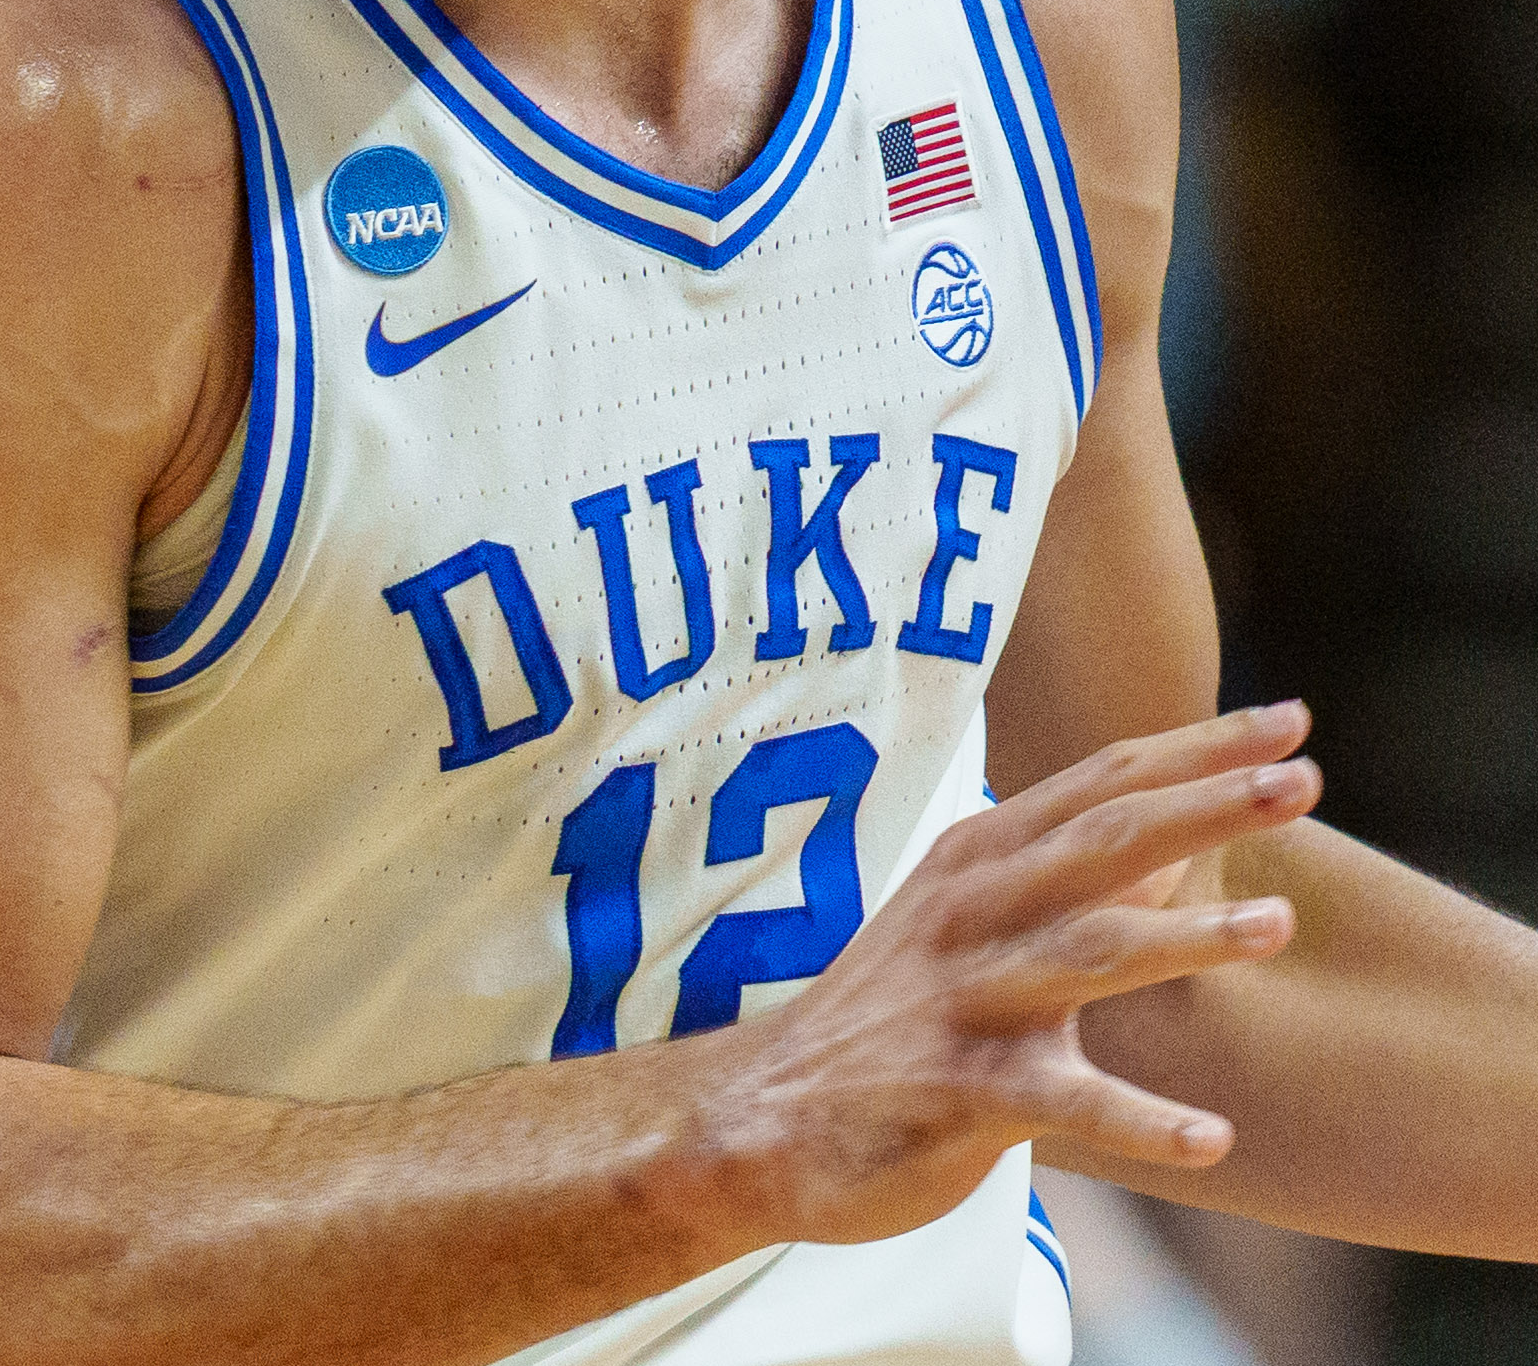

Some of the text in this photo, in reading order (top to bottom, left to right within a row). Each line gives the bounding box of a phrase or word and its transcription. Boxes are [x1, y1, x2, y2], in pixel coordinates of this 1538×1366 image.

[346, 201, 444, 245] NCAA
[924, 279, 984, 315] ACC
[383, 432, 1016, 772] DUKE
[551, 722, 879, 1061] 12
